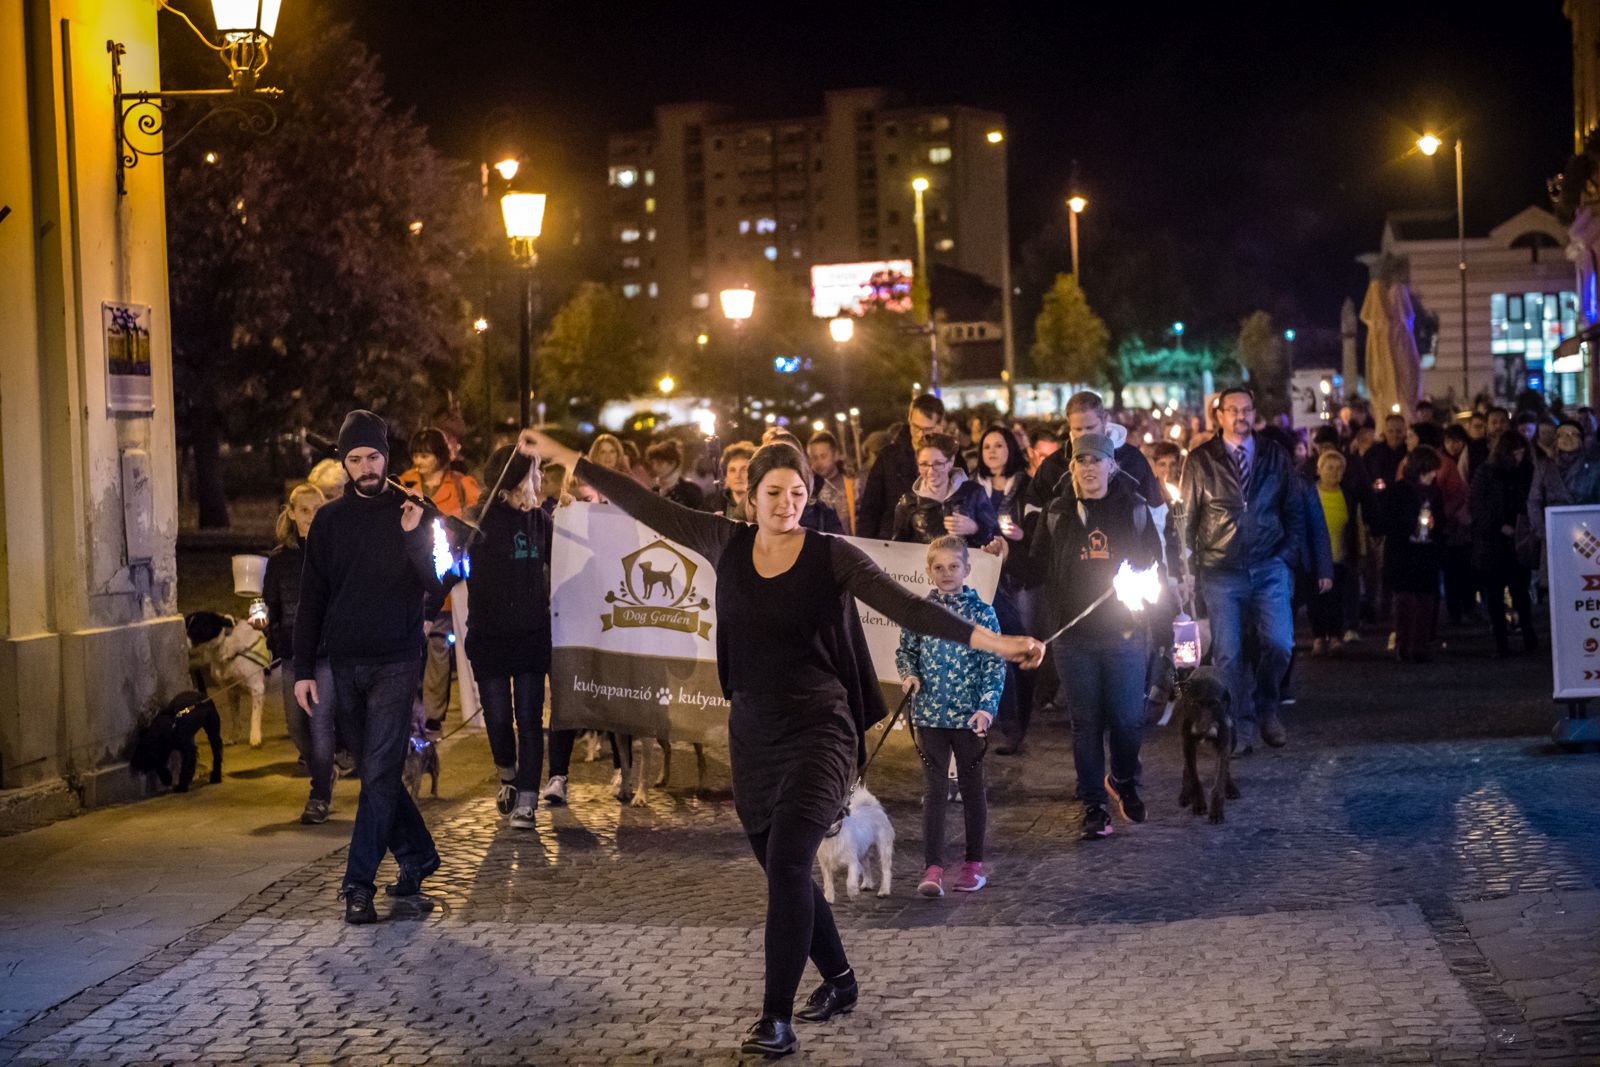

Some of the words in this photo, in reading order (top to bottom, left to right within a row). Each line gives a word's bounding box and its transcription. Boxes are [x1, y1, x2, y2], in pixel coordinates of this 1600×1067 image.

[623, 609, 647, 625] Dog
[650, 610, 690, 625] Garden
[859, 611, 900, 628] den.h
[573, 675, 652, 701] kutyapanzió
